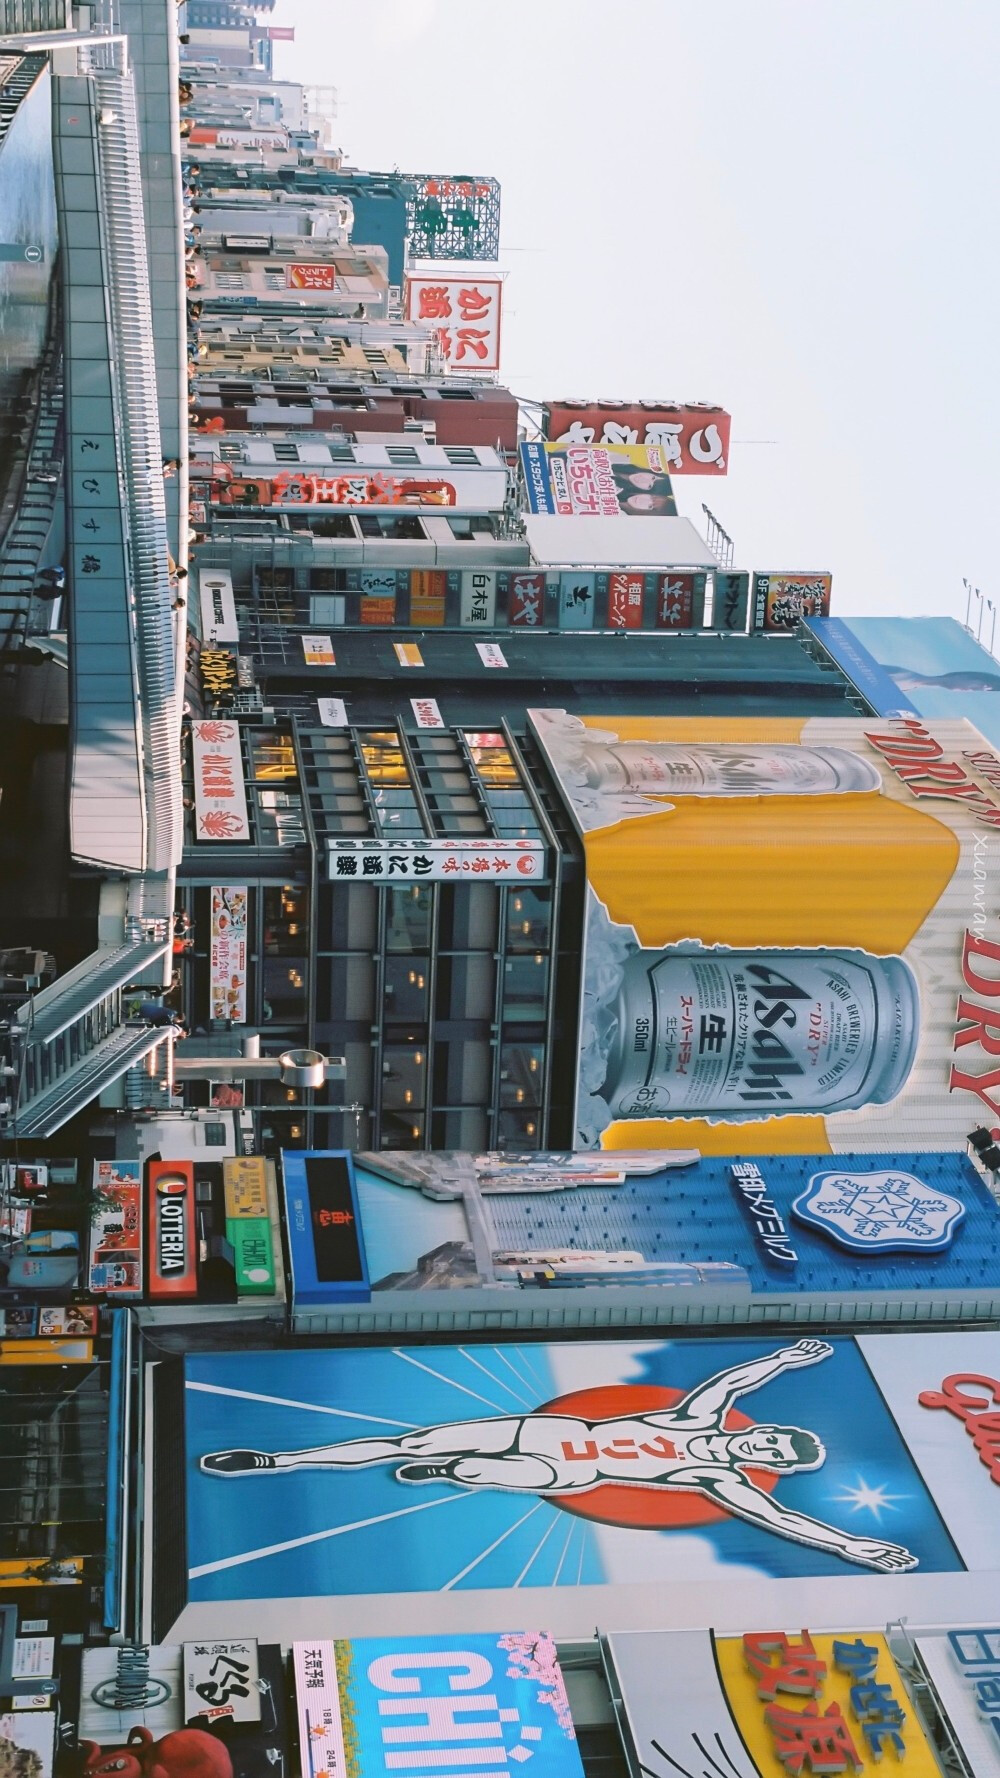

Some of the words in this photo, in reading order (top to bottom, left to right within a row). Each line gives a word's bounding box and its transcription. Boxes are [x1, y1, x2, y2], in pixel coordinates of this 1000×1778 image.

[298, 267, 327, 277] ドラッグ
[304, 277, 332, 288] ツルハ
[455, 287, 492, 360] かに
[552, 460, 564, 486] いちごナビ
[558, 488, 567, 498] 求人
[80, 440, 100, 574] えびす橋
[211, 588, 222, 608] HONOLULU
[471, 574, 490, 622] 白木屋
[547, 584, 557, 598] 5F
[611, 574, 628, 628] ダイニング
[628, 582, 642, 606] 相席
[758, 578, 769, 592] 9F
[214, 608, 224, 624] COFFEE
[201, 754, 235, 798] かに道楽
[665, 762, 694, 775] 生
[695, 748, 779, 791] Asahi
[336, 854, 434, 876] かに道楽
[441, 856, 511, 874] 本場の味
[826, 980, 851, 1002] ASAHI
[634, 1018, 649, 1052] 350ml
[665, 1016, 677, 1054] 生ビール
[676, 995, 694, 1075] スーパードライ
[699, 1014, 727, 1054] 生
[738, 964, 812, 1100] Asahi
[845, 1004, 860, 1054] BREWERIES
[817, 1058, 850, 1086] LIMITED
[628, 1087, 659, 1114] お酒
[244, 1140, 254, 1155] Toilets
[730, 1162, 798, 1260] 雪印メグミルク
[160, 1196, 184, 1270] LOTTERIA
[560, 1436, 686, 1461] グリコ
[194, 1644, 250, 1656] 道頓堀
[195, 1655, 250, 1706] くくる
[304, 1649, 324, 1688] 天気予報
[366, 1651, 511, 1778] CHI
[743, 1629, 864, 1776] 改源
[832, 1638, 906, 1758] かぜに
[323, 1708, 332, 1725] 18時
[326, 1750, 336, 1768] 24時
